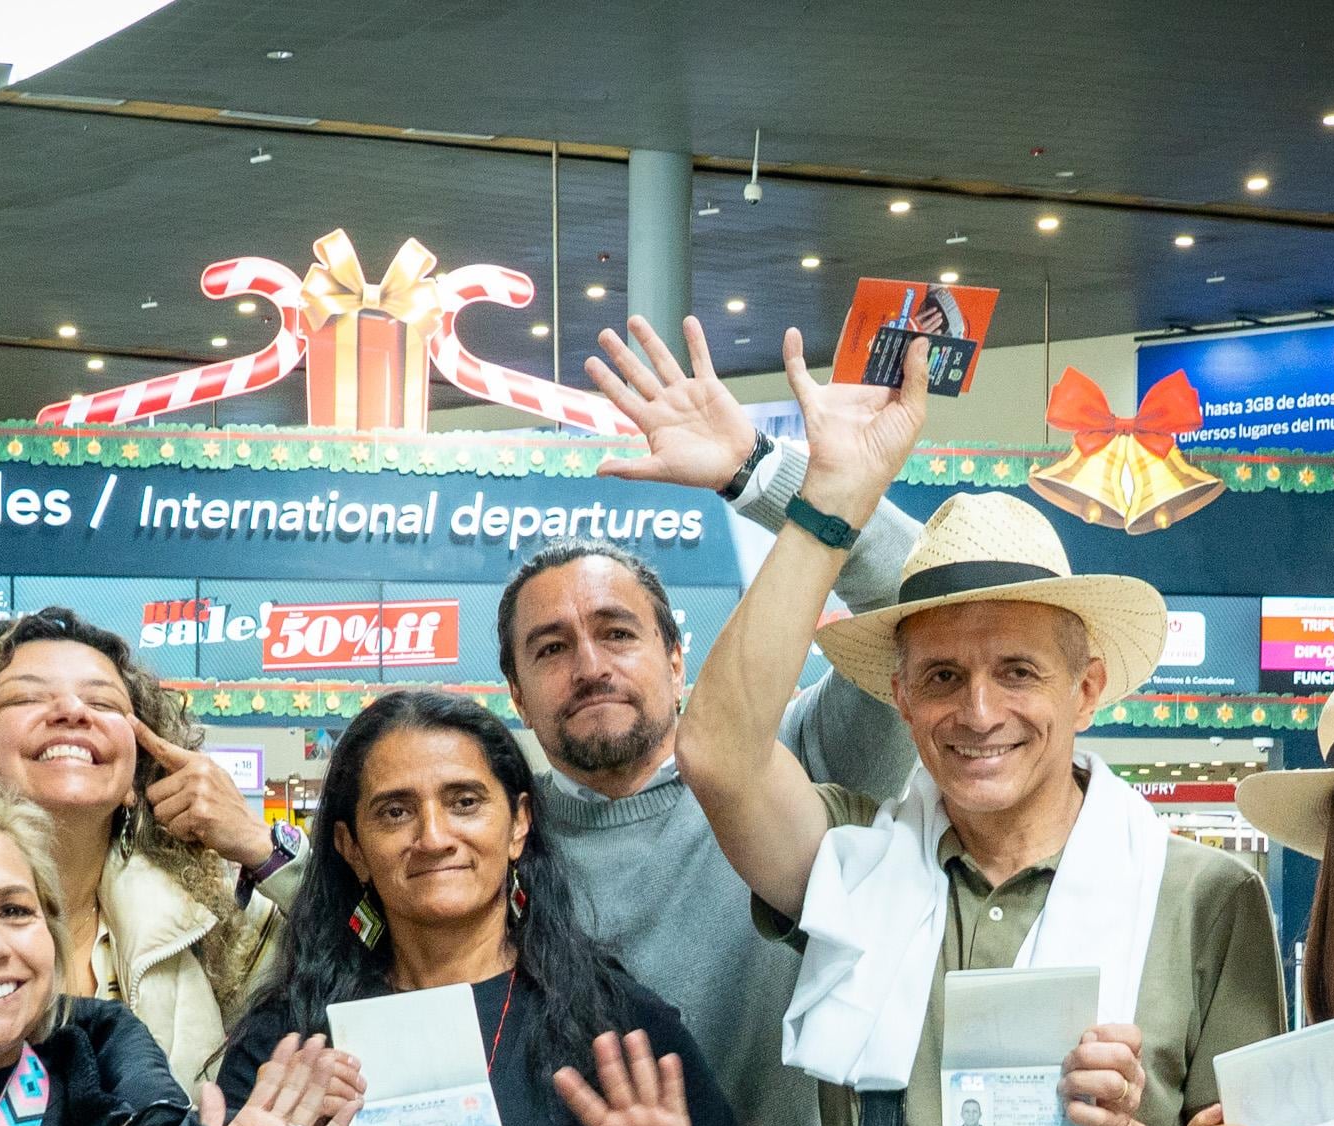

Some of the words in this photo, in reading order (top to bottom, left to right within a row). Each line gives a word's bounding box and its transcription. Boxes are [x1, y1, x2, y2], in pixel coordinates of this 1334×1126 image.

[1205, 401, 1243, 417] hasta
[1245, 398, 1273, 412] 3GB
[1276, 394, 1294, 410] de
[1179, 424, 1236, 444] diversos
[1239, 420, 1289, 440] lugares
[1291, 415, 1313, 434] del
[140, 484, 439, 536] International
[450, 491, 703, 550] departures
[139, 601, 273, 648] sale!
